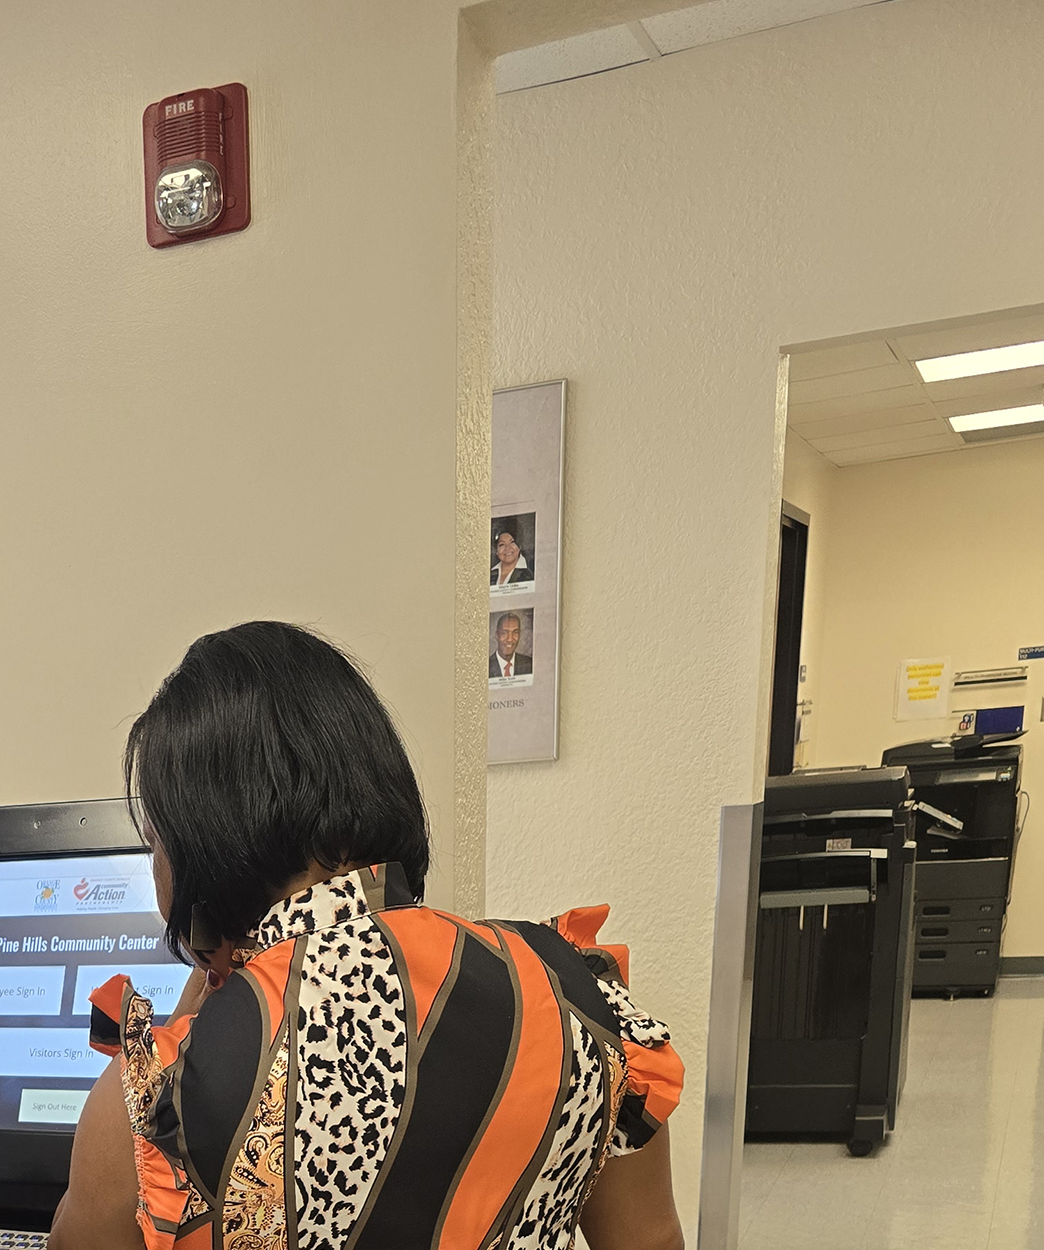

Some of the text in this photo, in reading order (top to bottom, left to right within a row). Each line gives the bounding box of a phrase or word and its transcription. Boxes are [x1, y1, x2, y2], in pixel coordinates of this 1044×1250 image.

[165, 100, 195, 117] FIRE
[83, 884, 126, 901] Action
[22, 936, 48, 952] Hills
[50, 935, 116, 954] Community
[118, 934, 160, 950] Center
[16, 986, 35, 997] Sign
[36, 986, 46, 996] In
[142, 985, 174, 996] Sign In
[29, 1047, 94, 1060] Visitors Sign In
[32, 1102, 77, 1111] Sign Out Here
